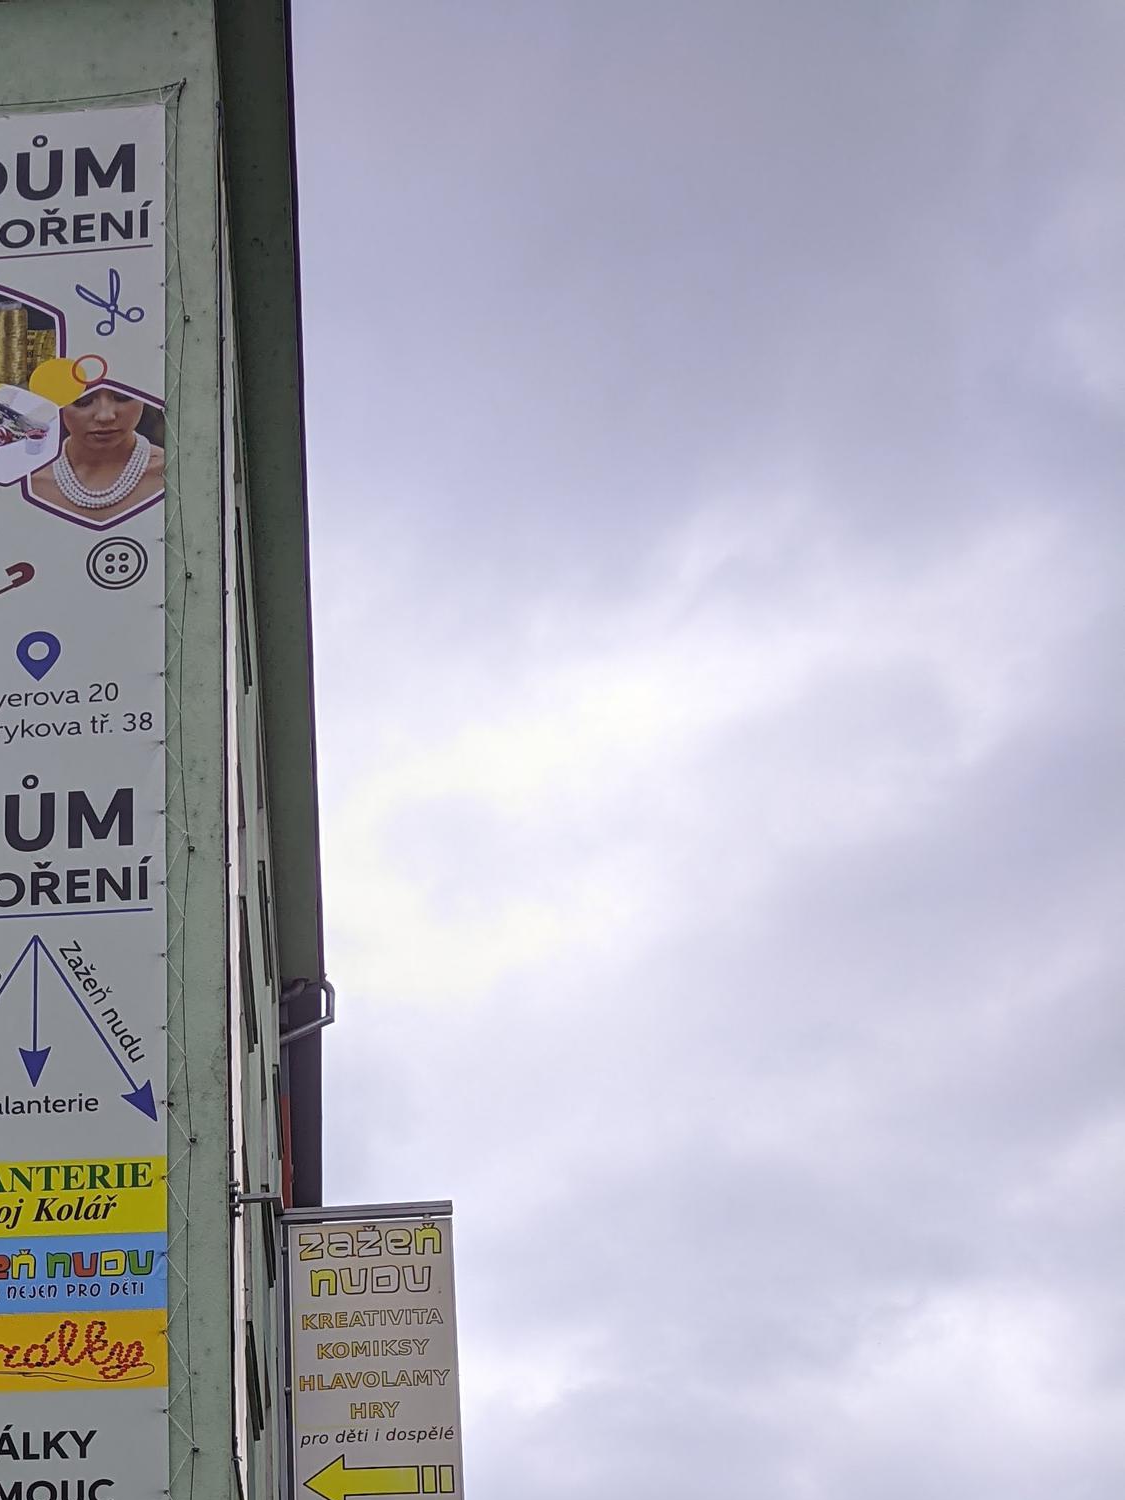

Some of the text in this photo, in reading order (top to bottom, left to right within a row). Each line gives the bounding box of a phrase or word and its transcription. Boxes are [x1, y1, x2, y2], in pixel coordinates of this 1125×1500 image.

[88, 682, 119, 704] 20
[89, 714, 115, 736] tř.
[122, 712, 154, 733] 38
[59, 940, 146, 1064] Zažeň nudu
[32, 1194, 119, 1223] Kolář
[66, 1283, 102, 1298] PRO
[110, 1278, 146, 1297] DĚTI
[301, 1307, 444, 1331] KREATIVITA
[316, 1338, 430, 1360] KOMIKSY
[299, 1368, 451, 1392] HLAVOLAMY
[350, 1400, 400, 1420] HRY
[300, 1426, 455, 1448] pro děti i dospělé
